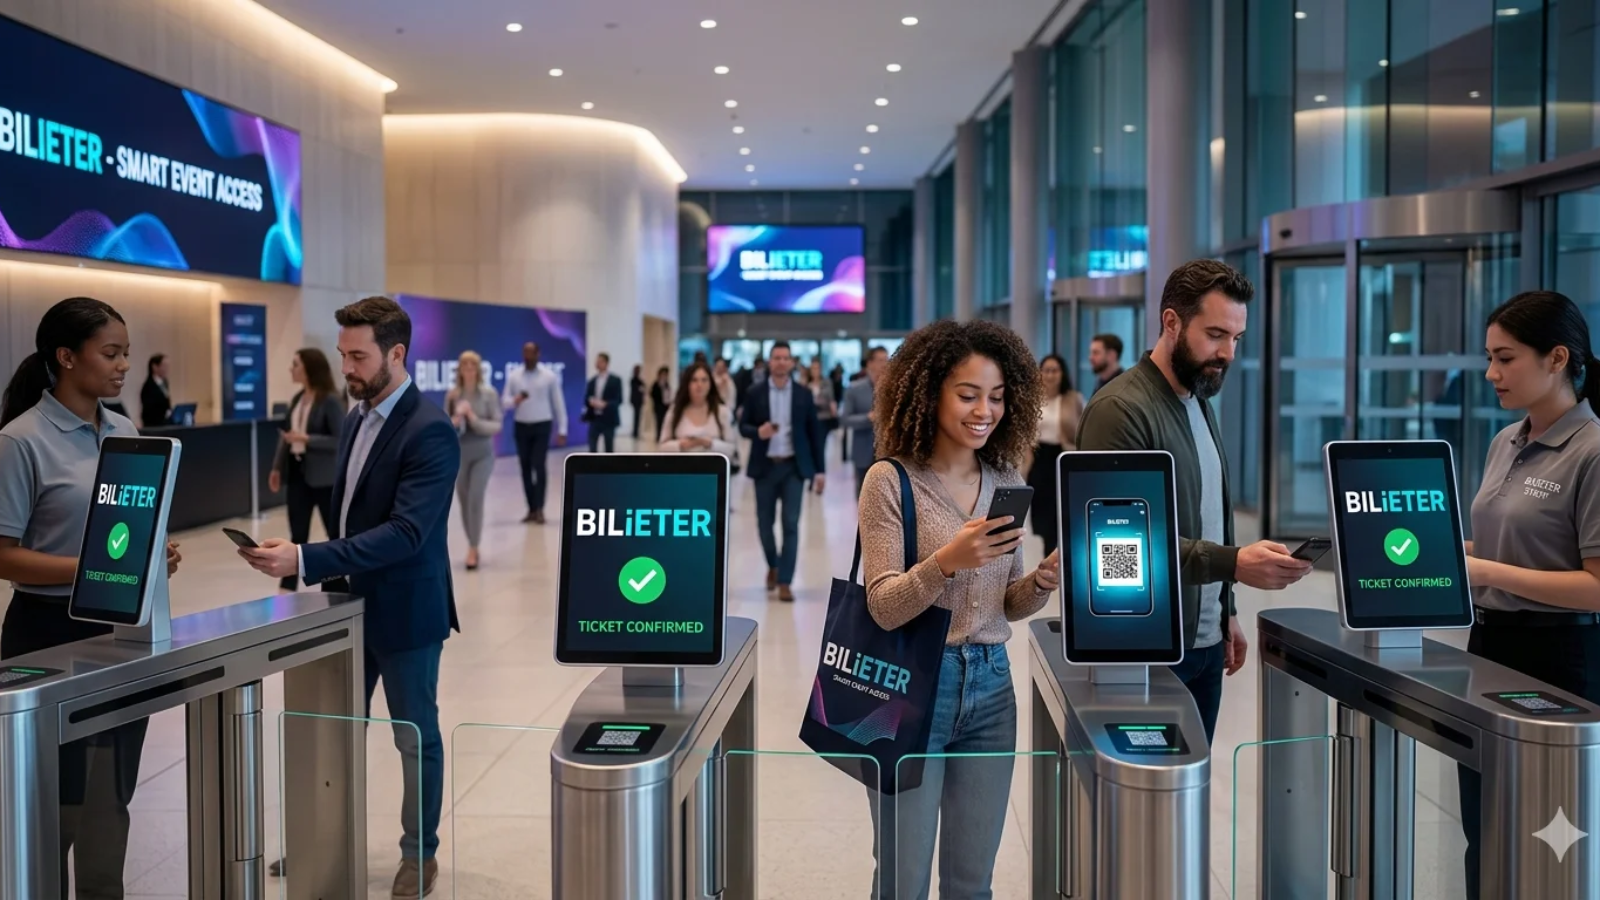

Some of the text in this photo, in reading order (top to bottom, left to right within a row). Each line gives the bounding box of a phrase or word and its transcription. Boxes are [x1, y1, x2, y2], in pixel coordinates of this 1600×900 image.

[0, 106, 103, 175] BILIETER
[116, 145, 170, 188] SMART
[171, 160, 215, 200] EVENT
[216, 174, 263, 212] ACCESS
[1358, 577, 1452, 589] TICKET CONFIRMED
[578, 620, 704, 634] TICKET CONFIRMED
